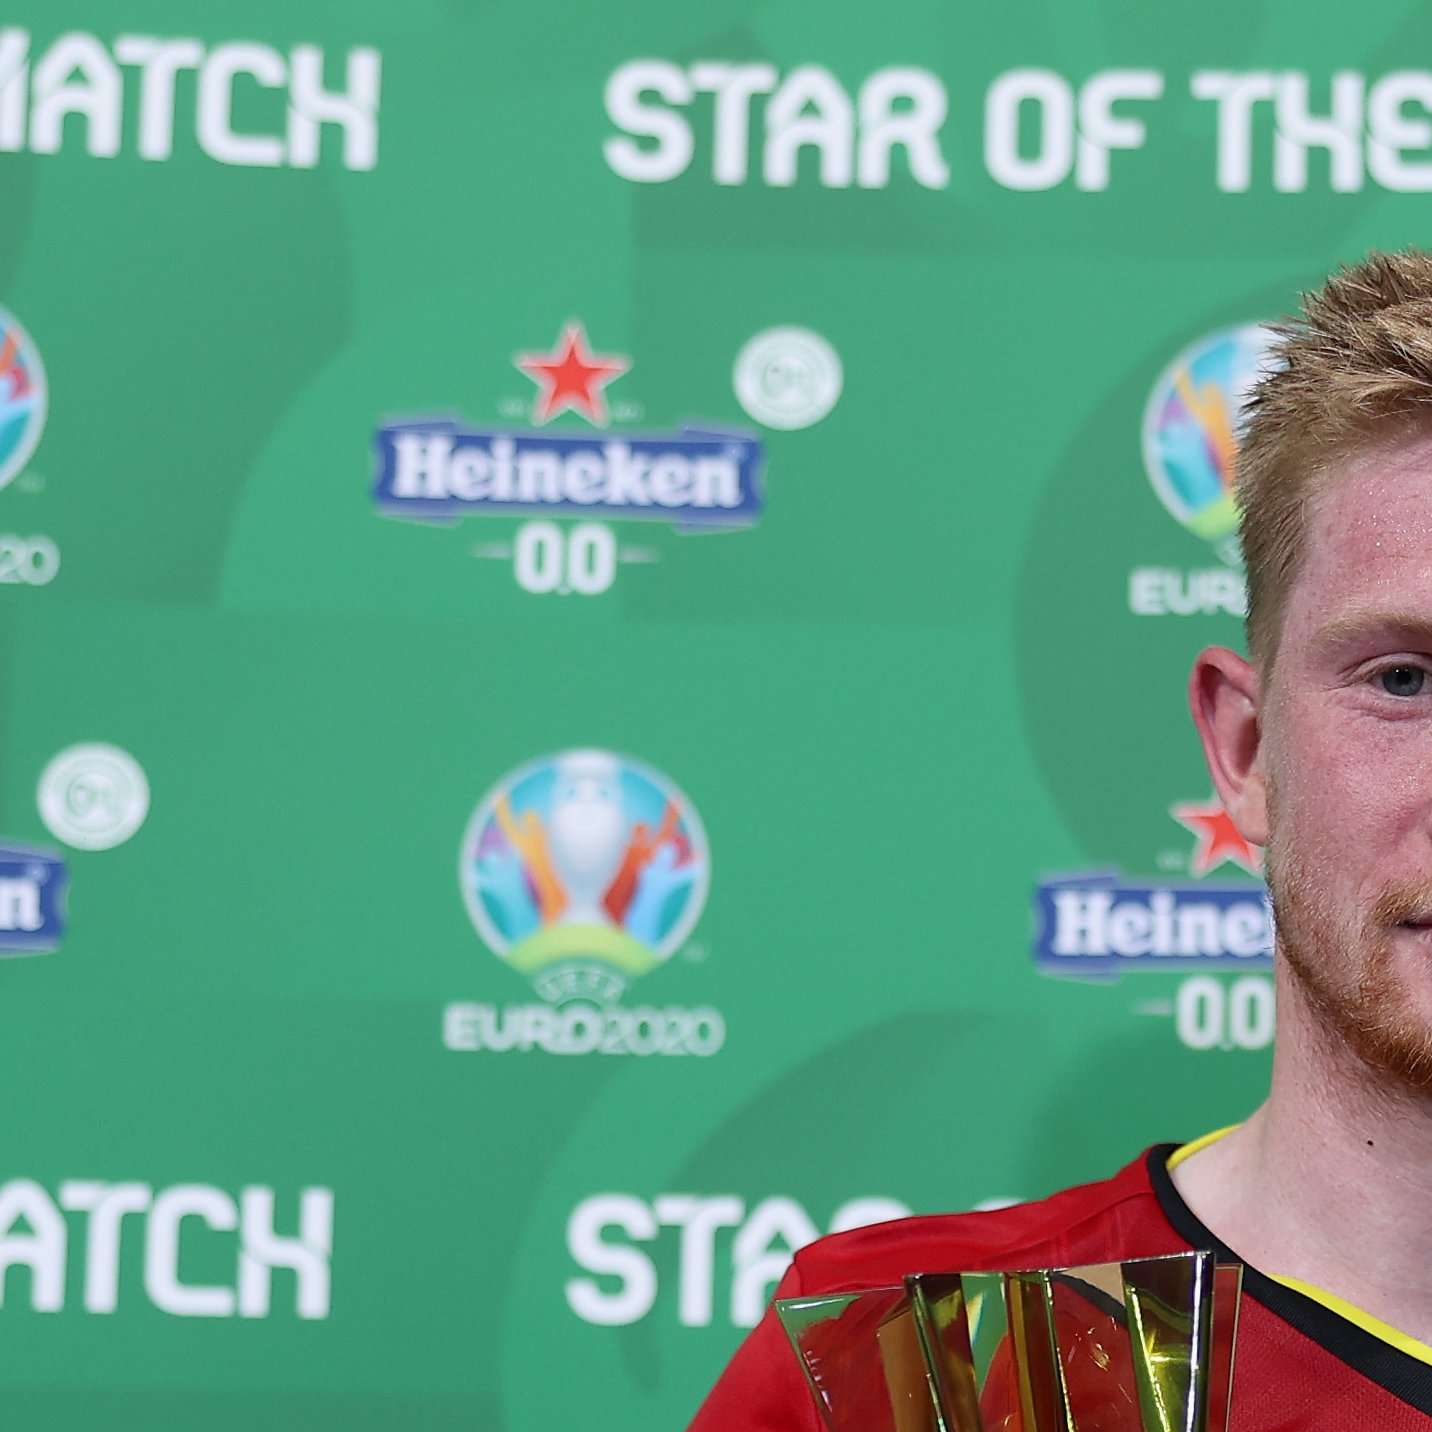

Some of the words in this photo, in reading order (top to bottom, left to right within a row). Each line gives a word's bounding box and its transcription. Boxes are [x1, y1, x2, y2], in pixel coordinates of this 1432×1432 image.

[0, 28, 381, 171] ATCH
[605, 60, 950, 190] STAR
[985, 69, 1164, 191] OF
[393, 434, 742, 507] Heineken
[514, 520, 617, 595] 0.0
[1054, 890, 1275, 957] Heine
[443, 1001, 725, 1057] EURO2020
[0, 1178, 334, 1320] ATCH
[565, 1193, 914, 1328] STA
